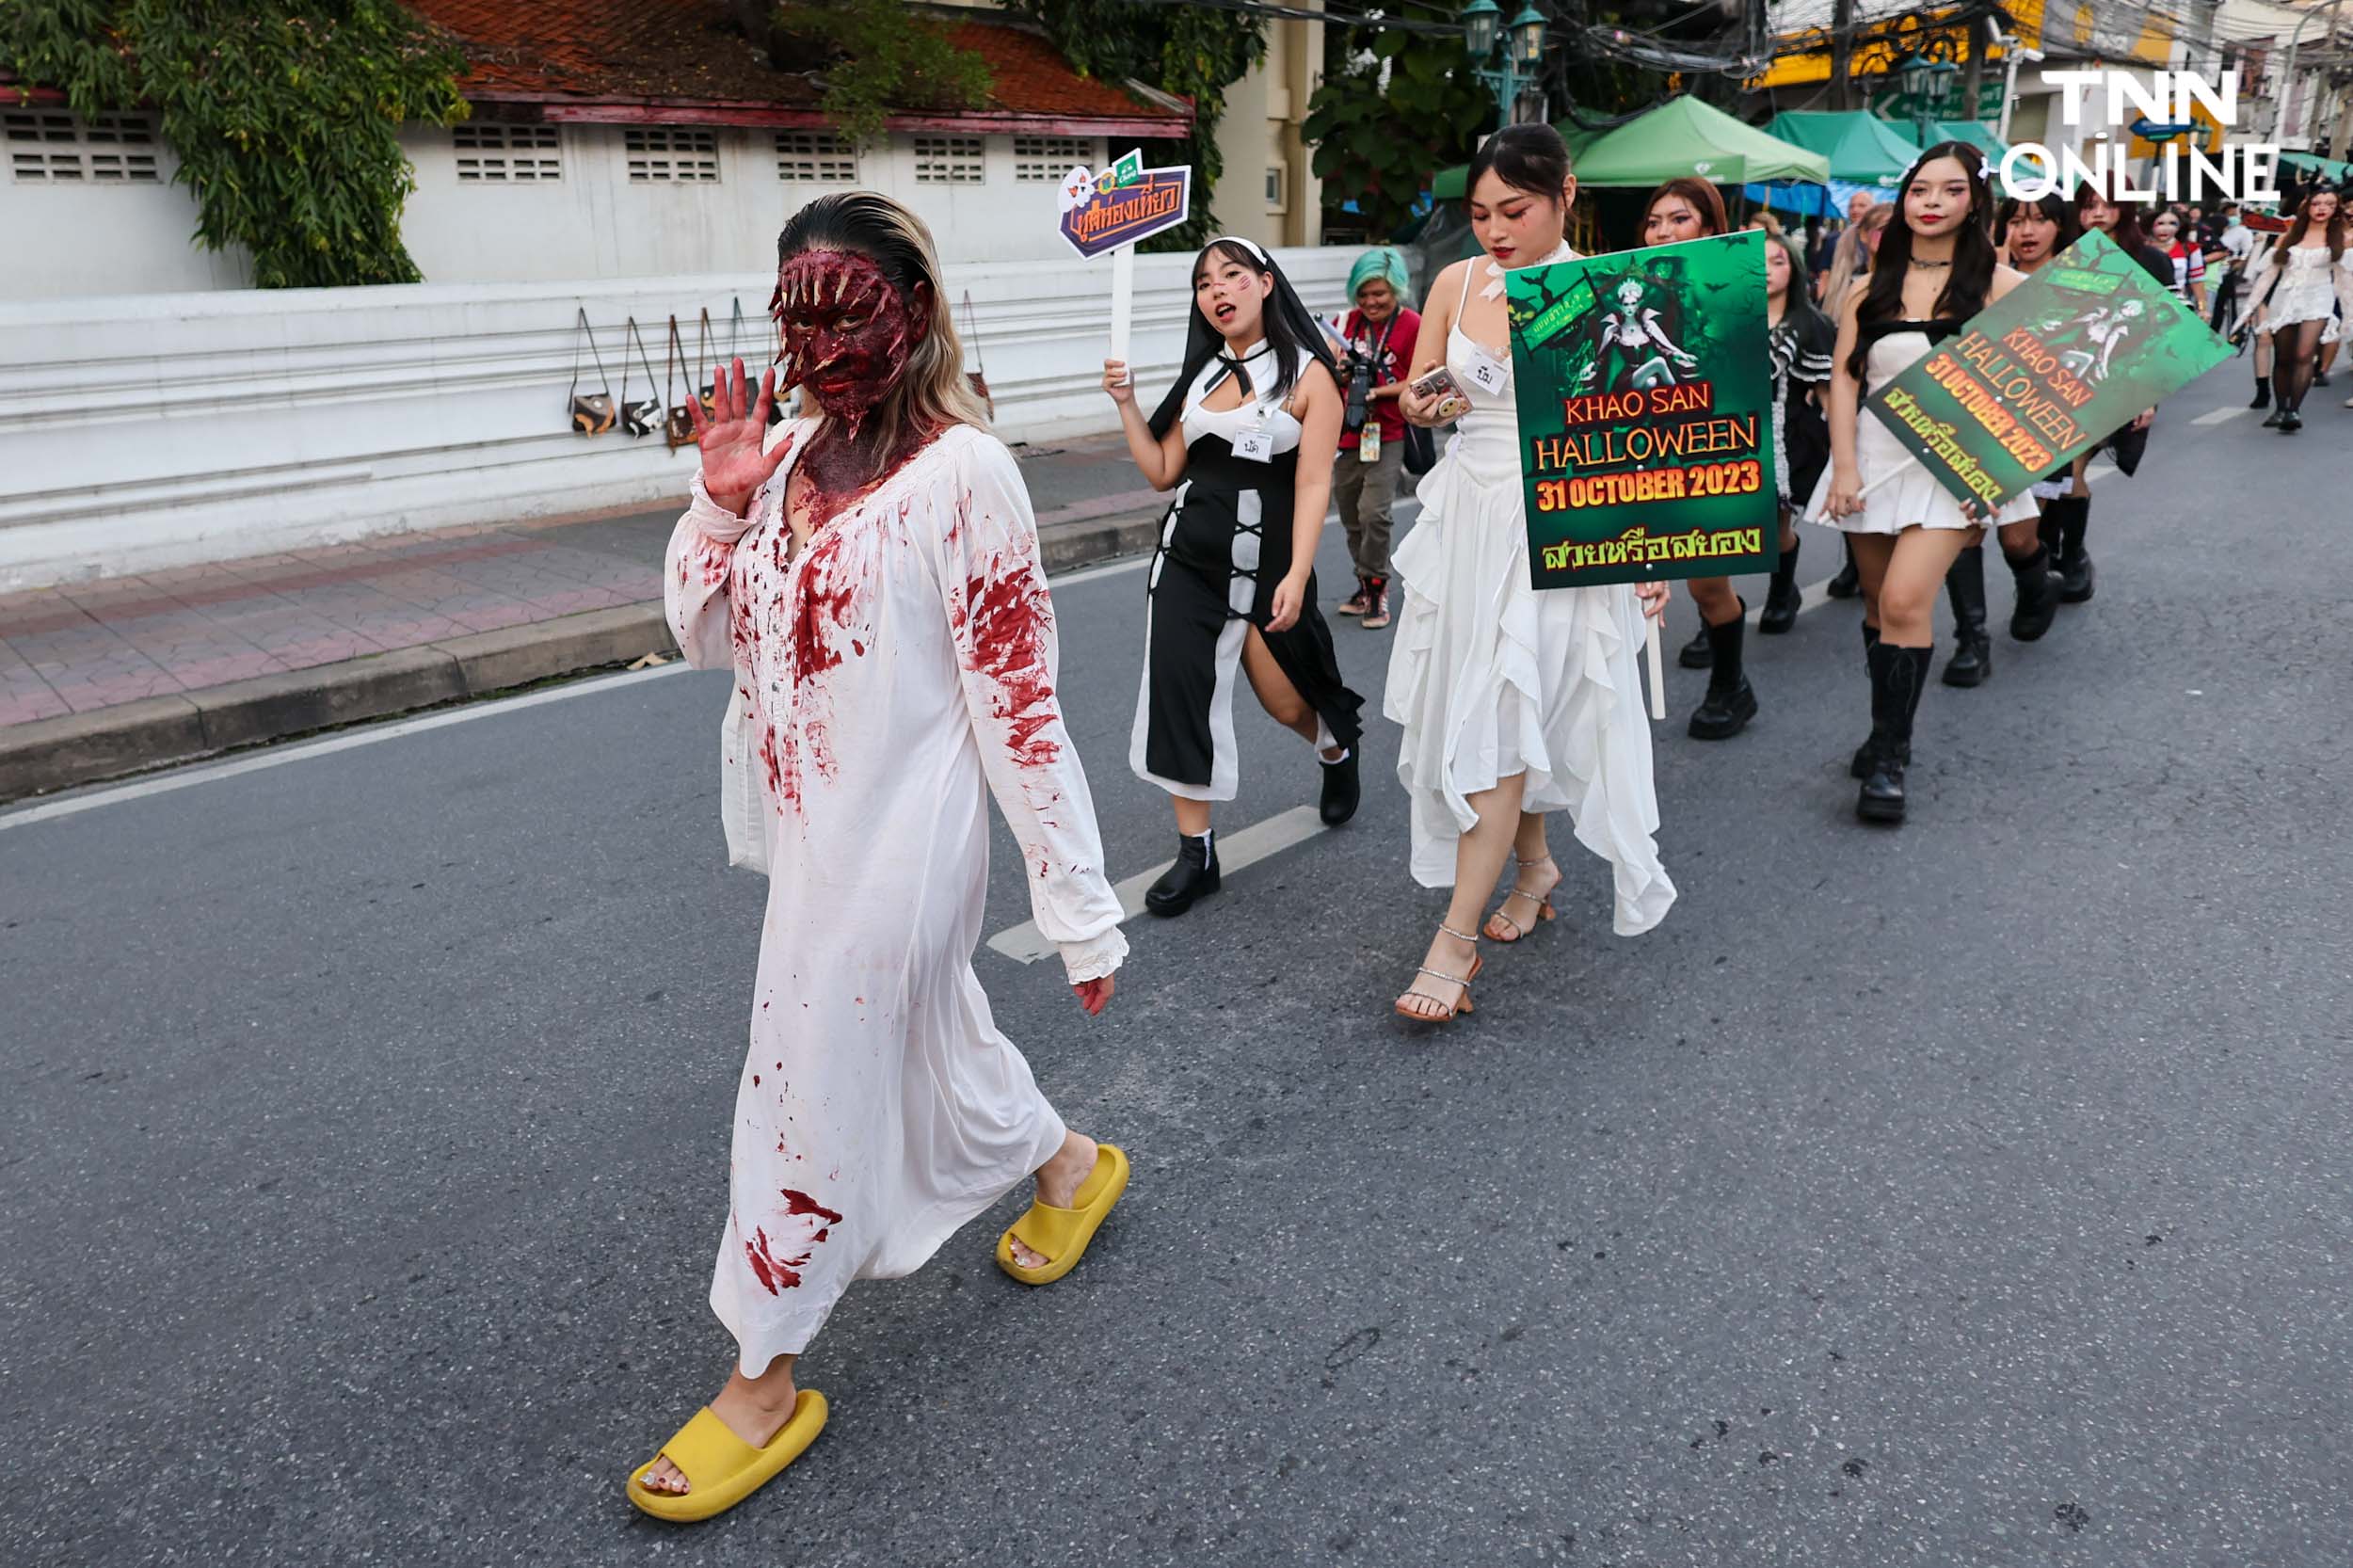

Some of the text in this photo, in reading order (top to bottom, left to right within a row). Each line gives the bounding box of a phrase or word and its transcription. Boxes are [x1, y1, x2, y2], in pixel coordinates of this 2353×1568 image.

[1956, 331, 2087, 451] HALLOWEEN
[2003, 327, 2094, 408] KHAO SAN
[1565, 383, 1710, 424] KHAO SAN
[1535, 417, 1756, 470] HALLOWEEN
[2000, 427, 2054, 472] 2023
[1569, 468, 1685, 507] OCTOBER
[1689, 460, 1760, 497] 2023
[1543, 527, 1761, 570] สวยหรือสยอง
